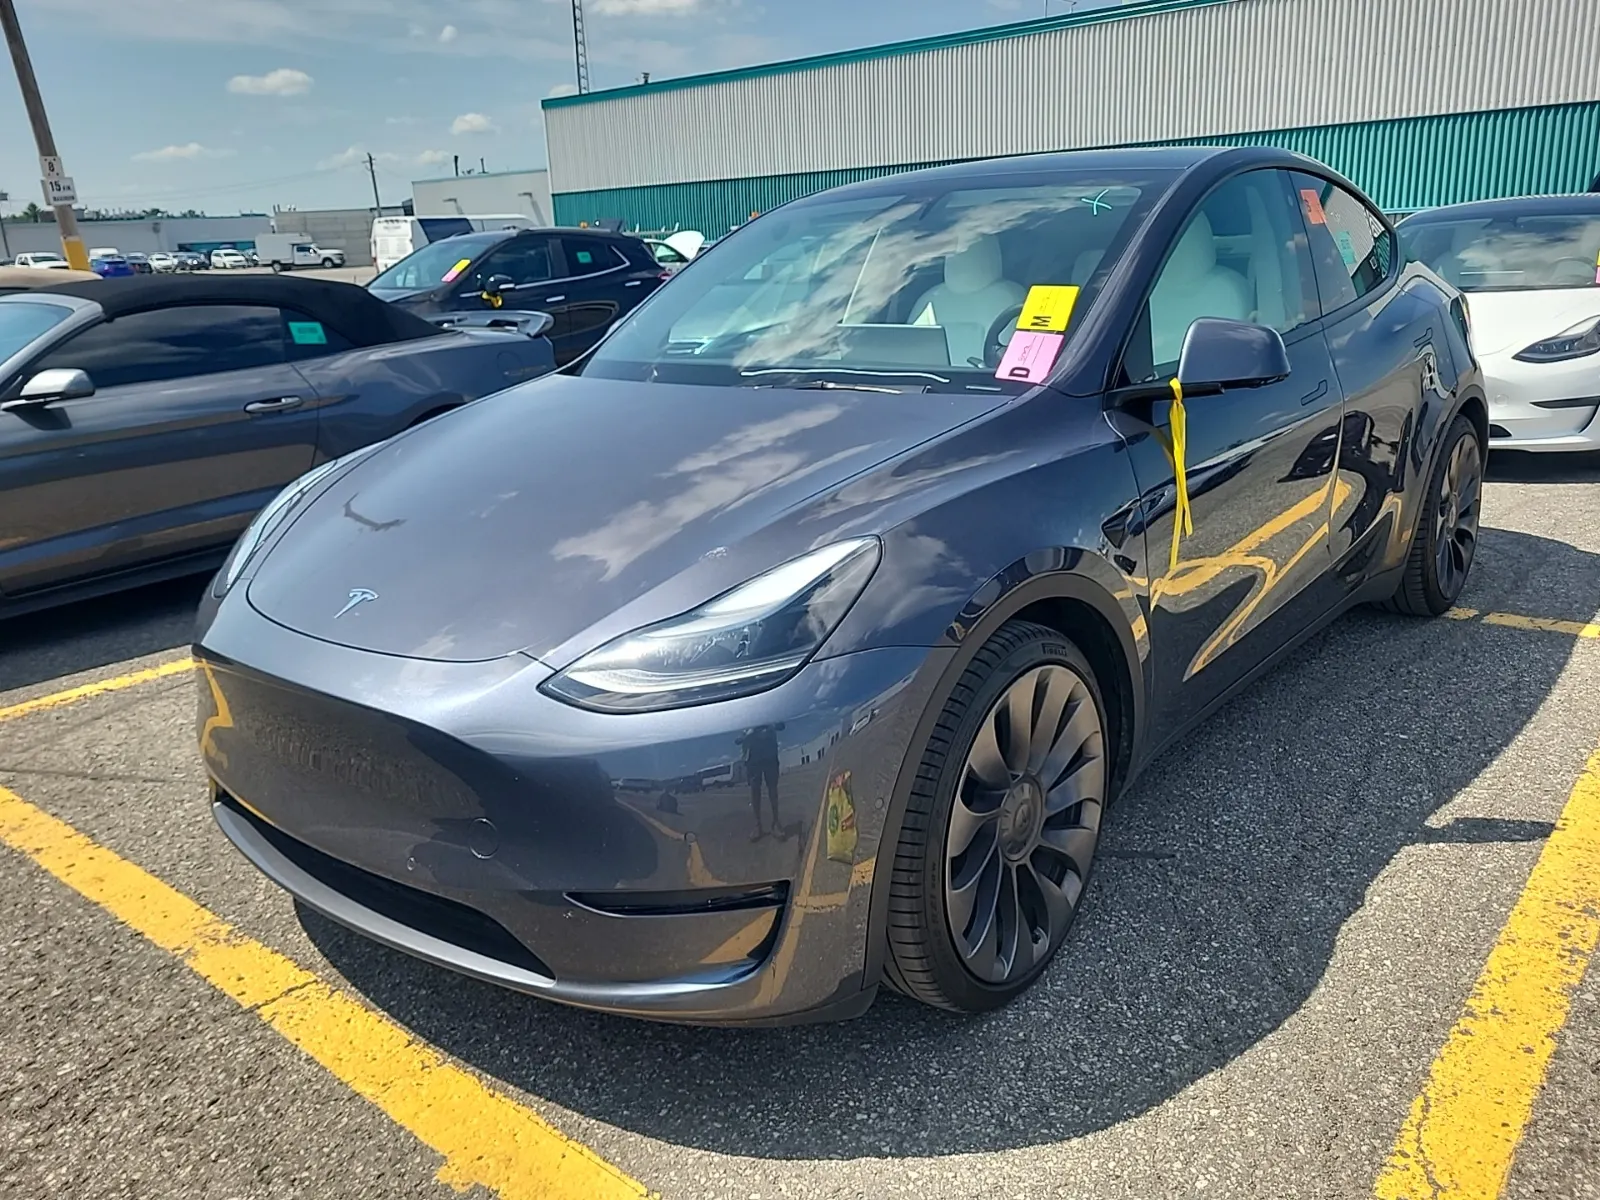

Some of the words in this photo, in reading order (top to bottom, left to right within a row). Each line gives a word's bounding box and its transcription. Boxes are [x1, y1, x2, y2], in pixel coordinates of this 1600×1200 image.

[49, 180, 61, 192] 15
[1030, 315, 1052, 327] M
[1008, 366, 1031, 378] D
[1041, 642, 1067, 657] PIRELLI
